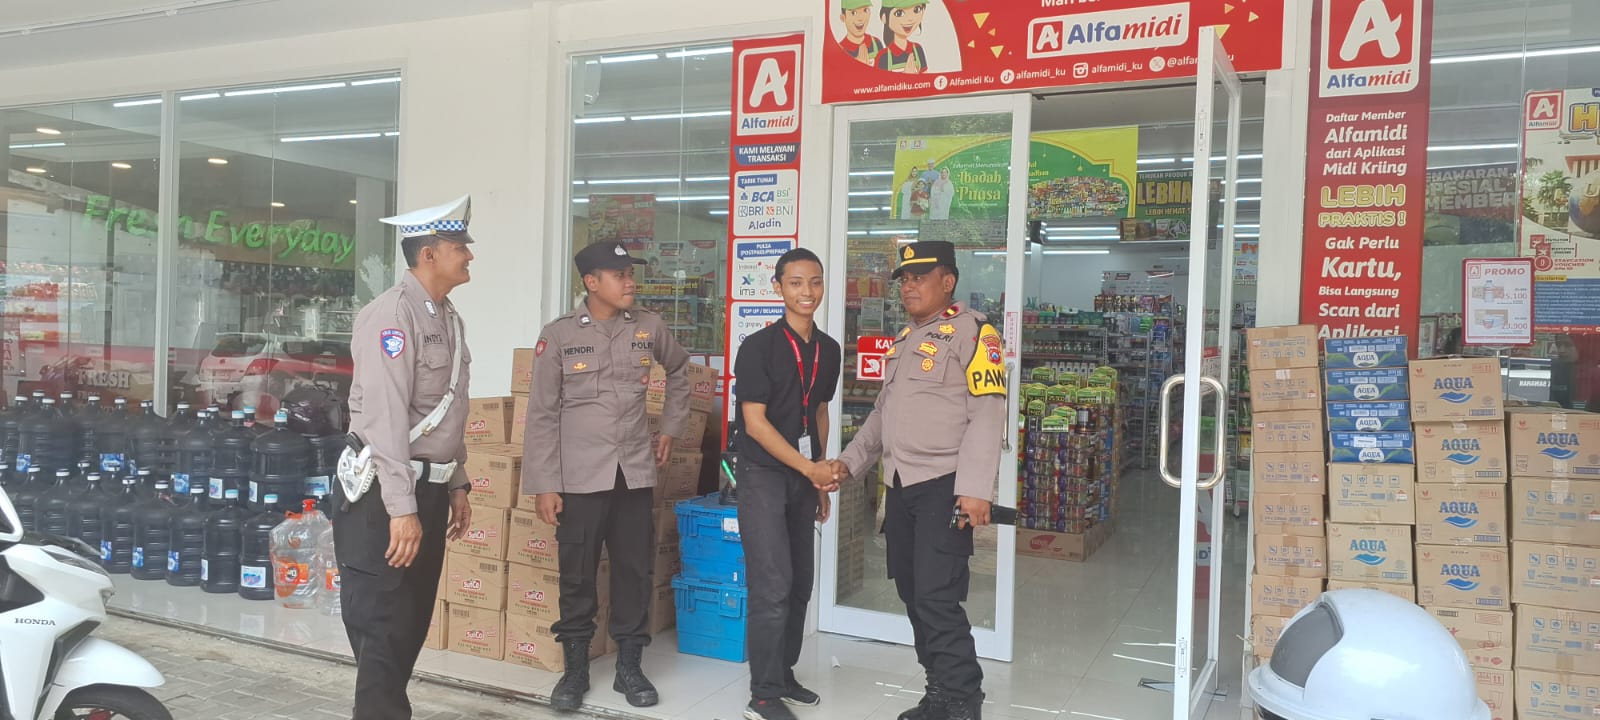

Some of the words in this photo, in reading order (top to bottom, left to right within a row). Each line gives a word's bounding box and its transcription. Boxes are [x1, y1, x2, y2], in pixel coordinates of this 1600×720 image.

[1067, 13, 1183, 45] Alfamidi
[1016, 67, 1066, 79] alfamidi_ku
[1091, 61, 1143, 74] alfamidi_ku
[950, 75, 982, 87] Alfamidi
[984, 75, 995, 84] Ku
[1327, 70, 1411, 89] Alfamidi
[853, 80, 931, 95] www.alfamidiku.com
[741, 115, 794, 130] Alfamidi
[1326, 112, 1359, 123] Daftar
[1361, 109, 1406, 121] Member
[1324, 124, 1408, 144] Alfamidi
[739, 146, 759, 155] KAMI
[760, 145, 795, 154] MELAYANI
[1326, 148, 1351, 159] dari
[1354, 145, 1406, 160] Aplikasi
[747, 154, 786, 163] TRANSAKSI
[1323, 162, 1357, 176] Midi
[1361, 162, 1407, 176] Kriing
[1426, 168, 1509, 182] ENAWARAN
[751, 191, 775, 202] BCA
[957, 186, 1002, 201] Puasa
[1137, 181, 1192, 204] LEBHA
[1321, 184, 1406, 208] LEBIH
[1425, 192, 1515, 213] MEMBER
[748, 205, 764, 216] BRI
[775, 205, 793, 216] BNI
[748, 218, 782, 231] Aladin
[1318, 211, 1396, 228] PRAKTIS
[205, 209, 356, 263] Everyday
[1325, 236, 1355, 249] Gak
[1359, 235, 1400, 249] Perlu
[1321, 257, 1402, 281] Kartu,
[1484, 268, 1525, 276] PROMO
[1319, 286, 1341, 296] Bisa
[1345, 286, 1399, 298] Langsung
[1319, 303, 1360, 317] Scan
[1365, 303, 1400, 318] dari
[925, 331, 954, 342] POLRI
[563, 346, 595, 356] HENDRI
[77, 369, 130, 388] FRESH
[972, 370, 1006, 390] PAW
[1433, 377, 1474, 391] AQUA
[1441, 439, 1481, 453] AQUA
[1536, 433, 1580, 447] AQUA
[1439, 502, 1479, 515] AQUA
[468, 531, 485, 540] SunCo
[528, 540, 547, 549] SunCo
[1350, 540, 1387, 553] AQUA
[1440, 564, 1481, 578] AQUA
[463, 580, 481, 589] SunCo
[525, 591, 543, 601] SunCo
[15, 618, 56, 626] HONDA
[466, 631, 484, 639] SunCo
